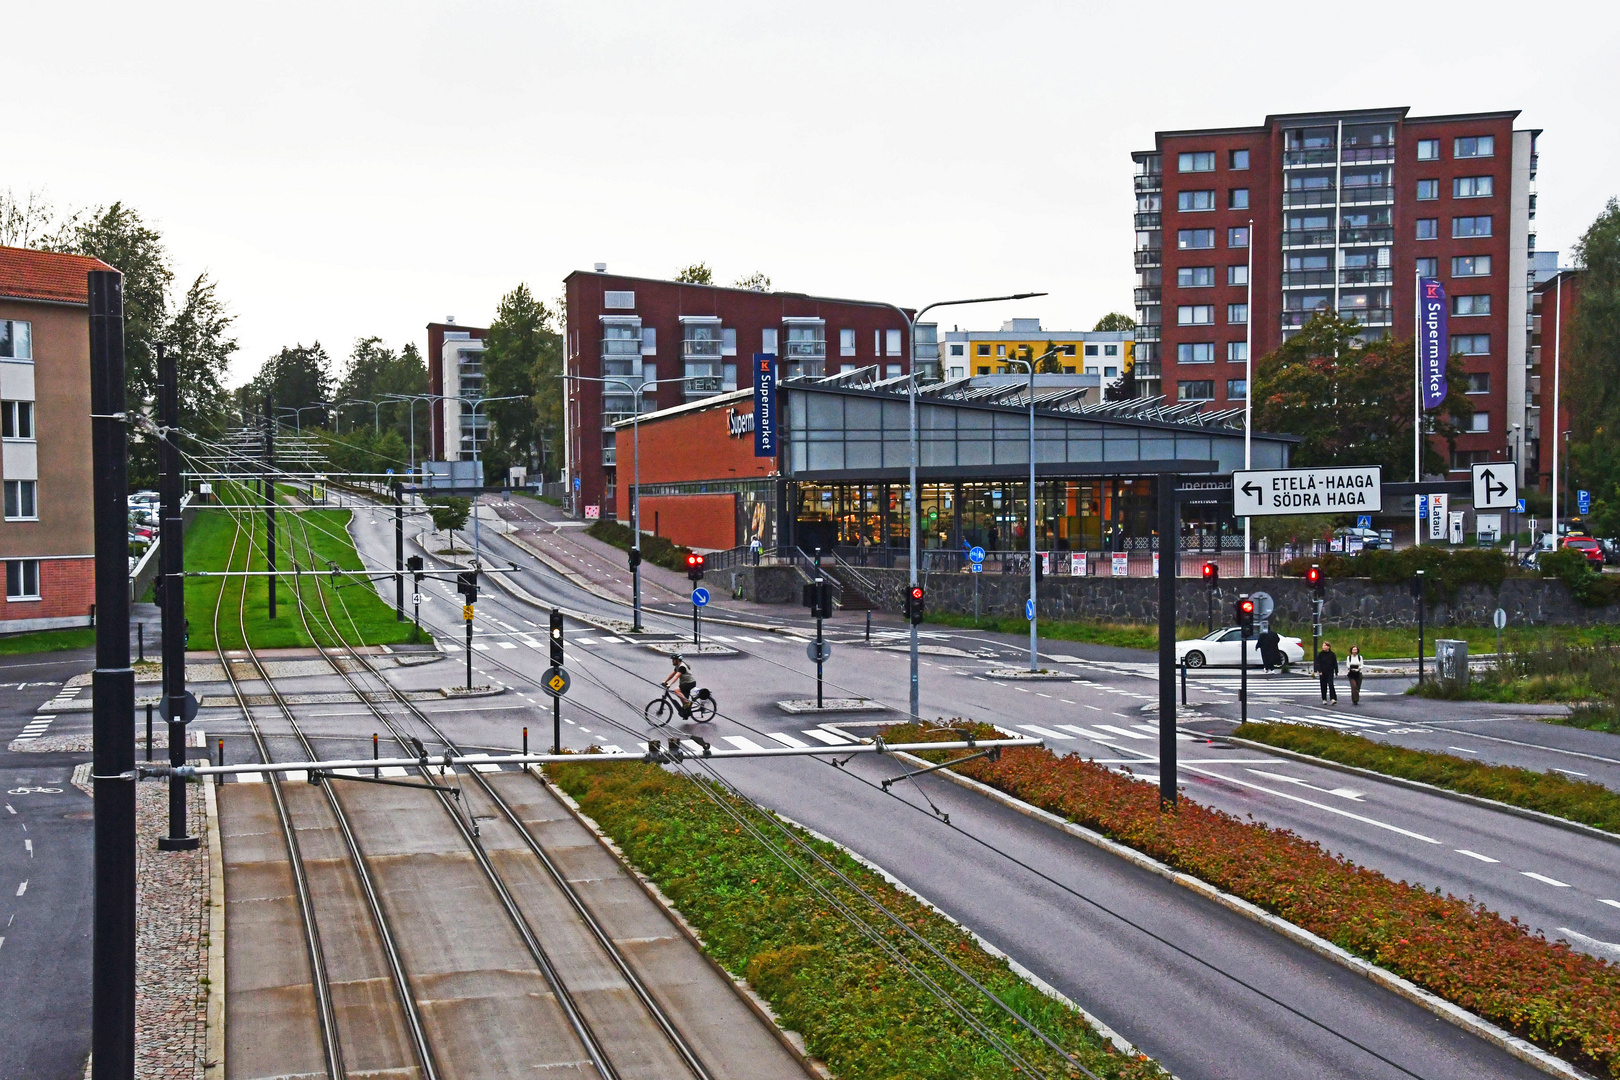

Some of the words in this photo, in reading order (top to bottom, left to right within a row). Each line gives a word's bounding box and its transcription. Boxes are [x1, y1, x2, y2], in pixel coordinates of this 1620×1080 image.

[1426, 284, 1439, 298] K
[1426, 303, 1442, 398] Supermarket
[760, 360, 770, 371] K
[760, 375, 772, 449] Supermarket
[731, 408, 755, 439] Superm
[1272, 474, 1374, 491] ETELÄ-HAAGA
[1273, 492, 1321, 507] SÖDRA
[1327, 491, 1366, 506] HAGA
[1433, 495, 1442, 505] K
[1580, 492, 1588, 500] P
[1433, 505, 1442, 536] Lataus
[554, 680, 560, 688] 2
